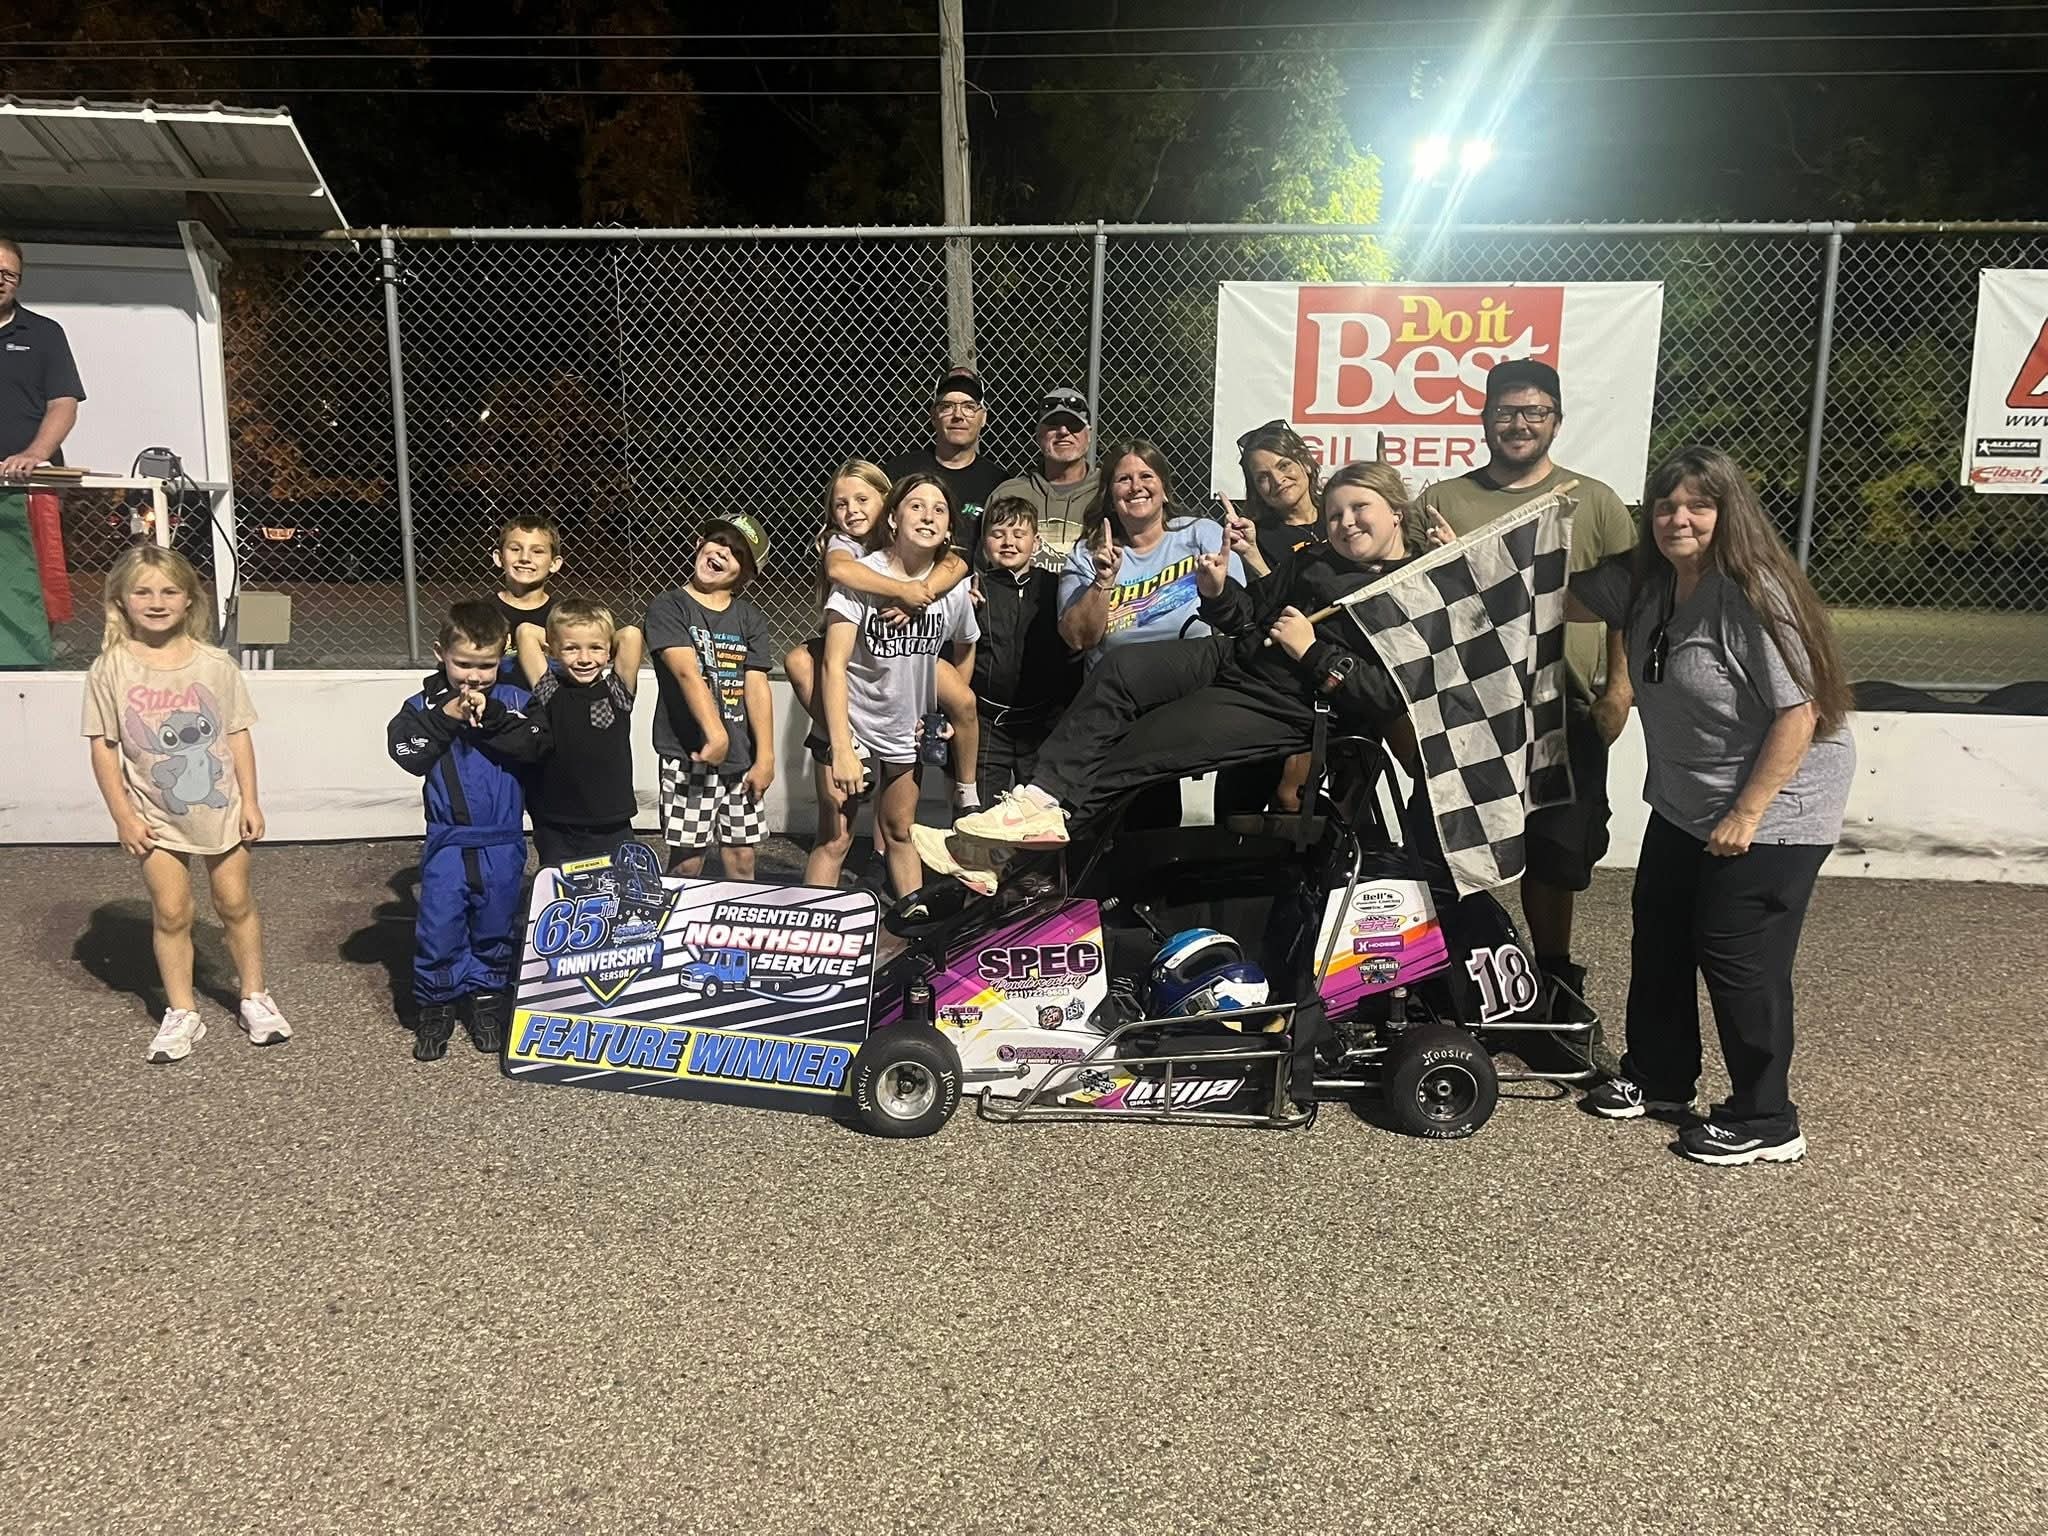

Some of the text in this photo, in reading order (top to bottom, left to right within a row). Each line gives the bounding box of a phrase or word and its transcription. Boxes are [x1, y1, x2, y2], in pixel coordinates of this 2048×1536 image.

[1396, 295, 1514, 343] Do it
[1304, 435, 1487, 467] GILBER
[127, 684, 199, 715] Stitch
[1363, 892, 1393, 901] Bell's
[715, 905, 838, 930] PRESENTED BY:
[685, 922, 865, 958] NORTHSIDE
[556, 942, 657, 977] ANNIVERSARY
[600, 968, 631, 982] SEASON
[754, 953, 857, 976] SERVICE
[978, 941, 1102, 981] SPEC
[1360, 961, 1399, 971] YOUTH SERIES
[1465, 944, 1537, 1023] 18
[515, 1013, 690, 1071] FEATURE
[687, 1032, 853, 1091] WINNER
